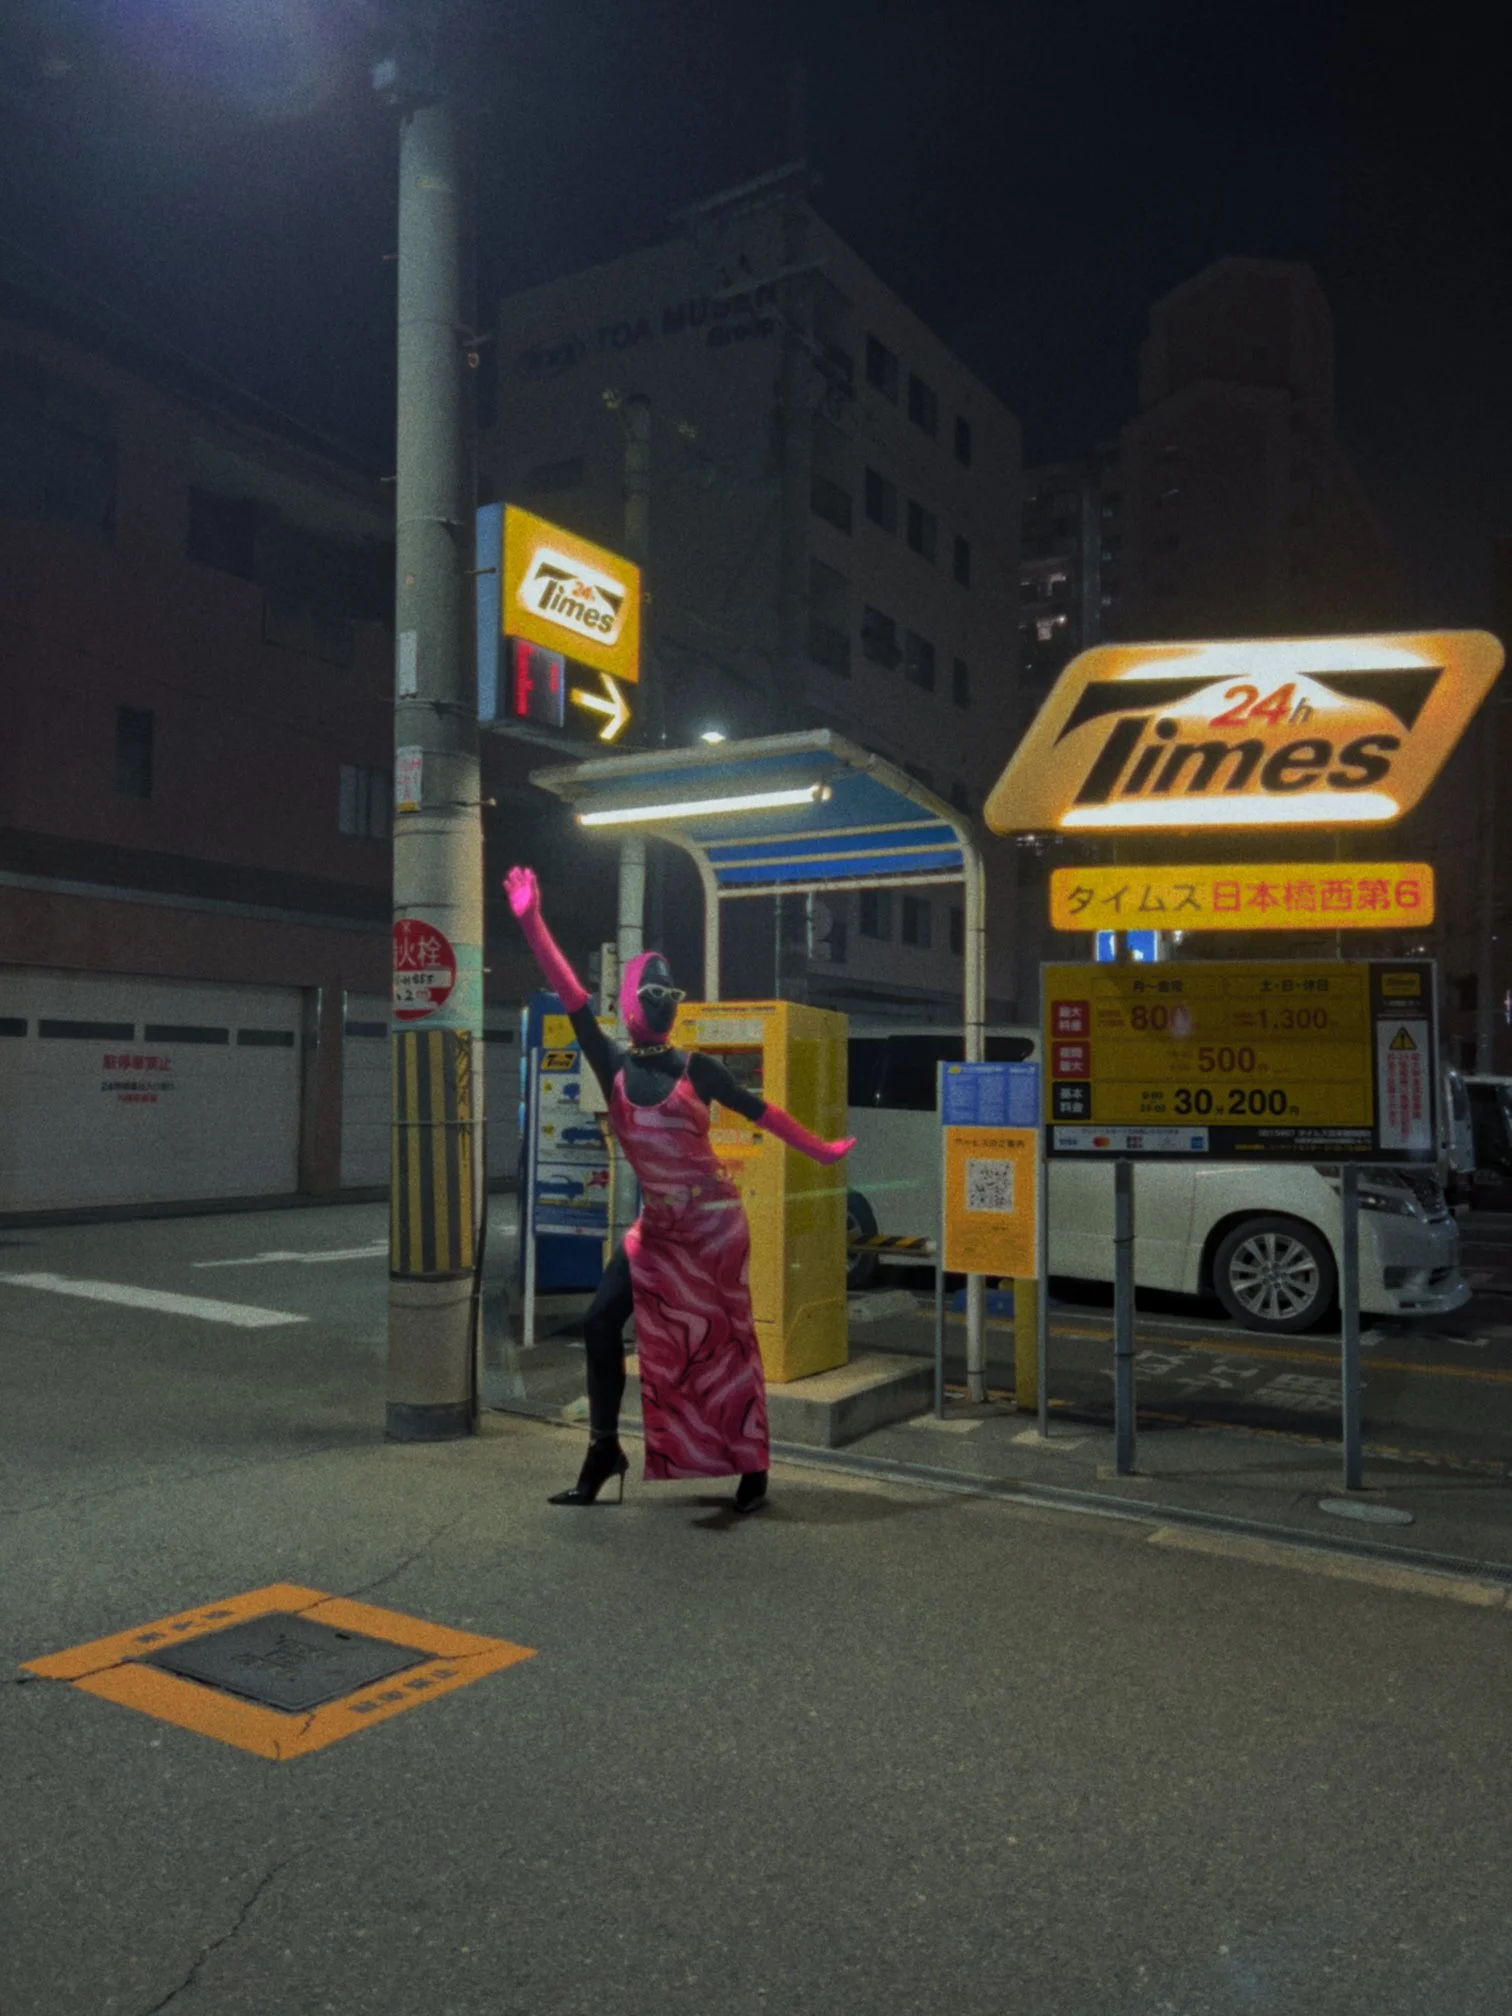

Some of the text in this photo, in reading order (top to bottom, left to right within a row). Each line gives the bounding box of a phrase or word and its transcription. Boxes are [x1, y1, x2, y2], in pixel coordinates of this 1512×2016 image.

[534, 562, 617, 634] Times
[1207, 681, 1313, 729] 24h
[1052, 674, 1402, 806] Times
[393, 935, 442, 970] 火栓
